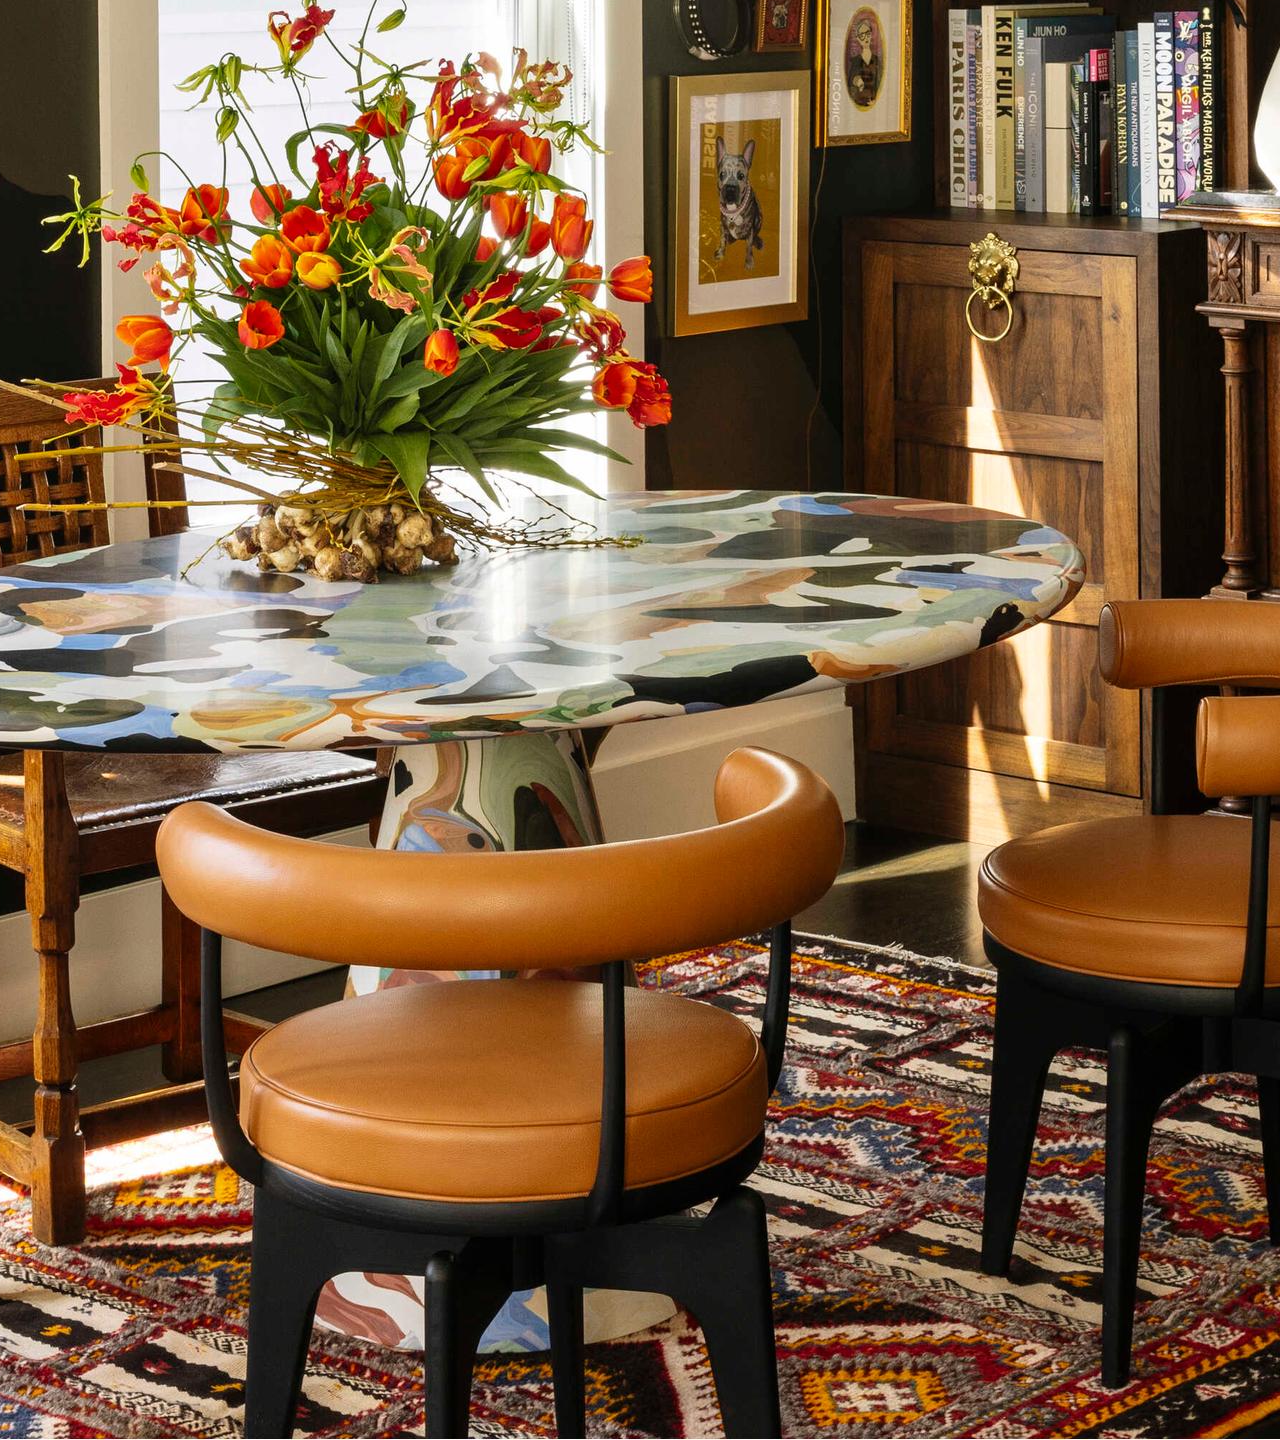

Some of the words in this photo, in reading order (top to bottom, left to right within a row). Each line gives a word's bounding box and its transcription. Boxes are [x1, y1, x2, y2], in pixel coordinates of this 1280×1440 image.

[995, 17, 1012, 57] KEN
[1016, 26, 1024, 50] JIUN
[1033, 26, 1053, 37] JIUN
[1054, 25, 1067, 36] HO
[1202, 31, 1212, 48] MR.
[1017, 51, 1024, 66] HO
[1142, 41, 1150, 78] HOME
[1155, 31, 1171, 92] MOON
[1201, 49, 1212, 71] KEN
[951, 41, 965, 121] PARIS
[985, 65, 993, 106] OBJECTS
[996, 66, 1012, 118] FULK
[1117, 83, 1126, 114] RYAN
[1181, 74, 1193, 115] VIRGIL
[969, 105, 977, 145] PAINTED
[985, 109, 993, 122] OF
[1017, 96, 1025, 150] EXPERIENCE
[1029, 90, 1038, 137] ICONIC
[1144, 105, 1152, 150] STANLEY
[1202, 110, 1213, 155] MAGICAL
[985, 125, 993, 155] DESIRE
[1117, 116, 1128, 164] KORBAN
[1131, 112, 1139, 167] ANTIQUARIANS
[1157, 92, 1175, 203] PARADISE
[1182, 118, 1192, 162] ABLOH
[952, 128, 965, 193] CHIC
[969, 148, 977, 182] LADIES
[1144, 152, 1153, 185] DIXON
